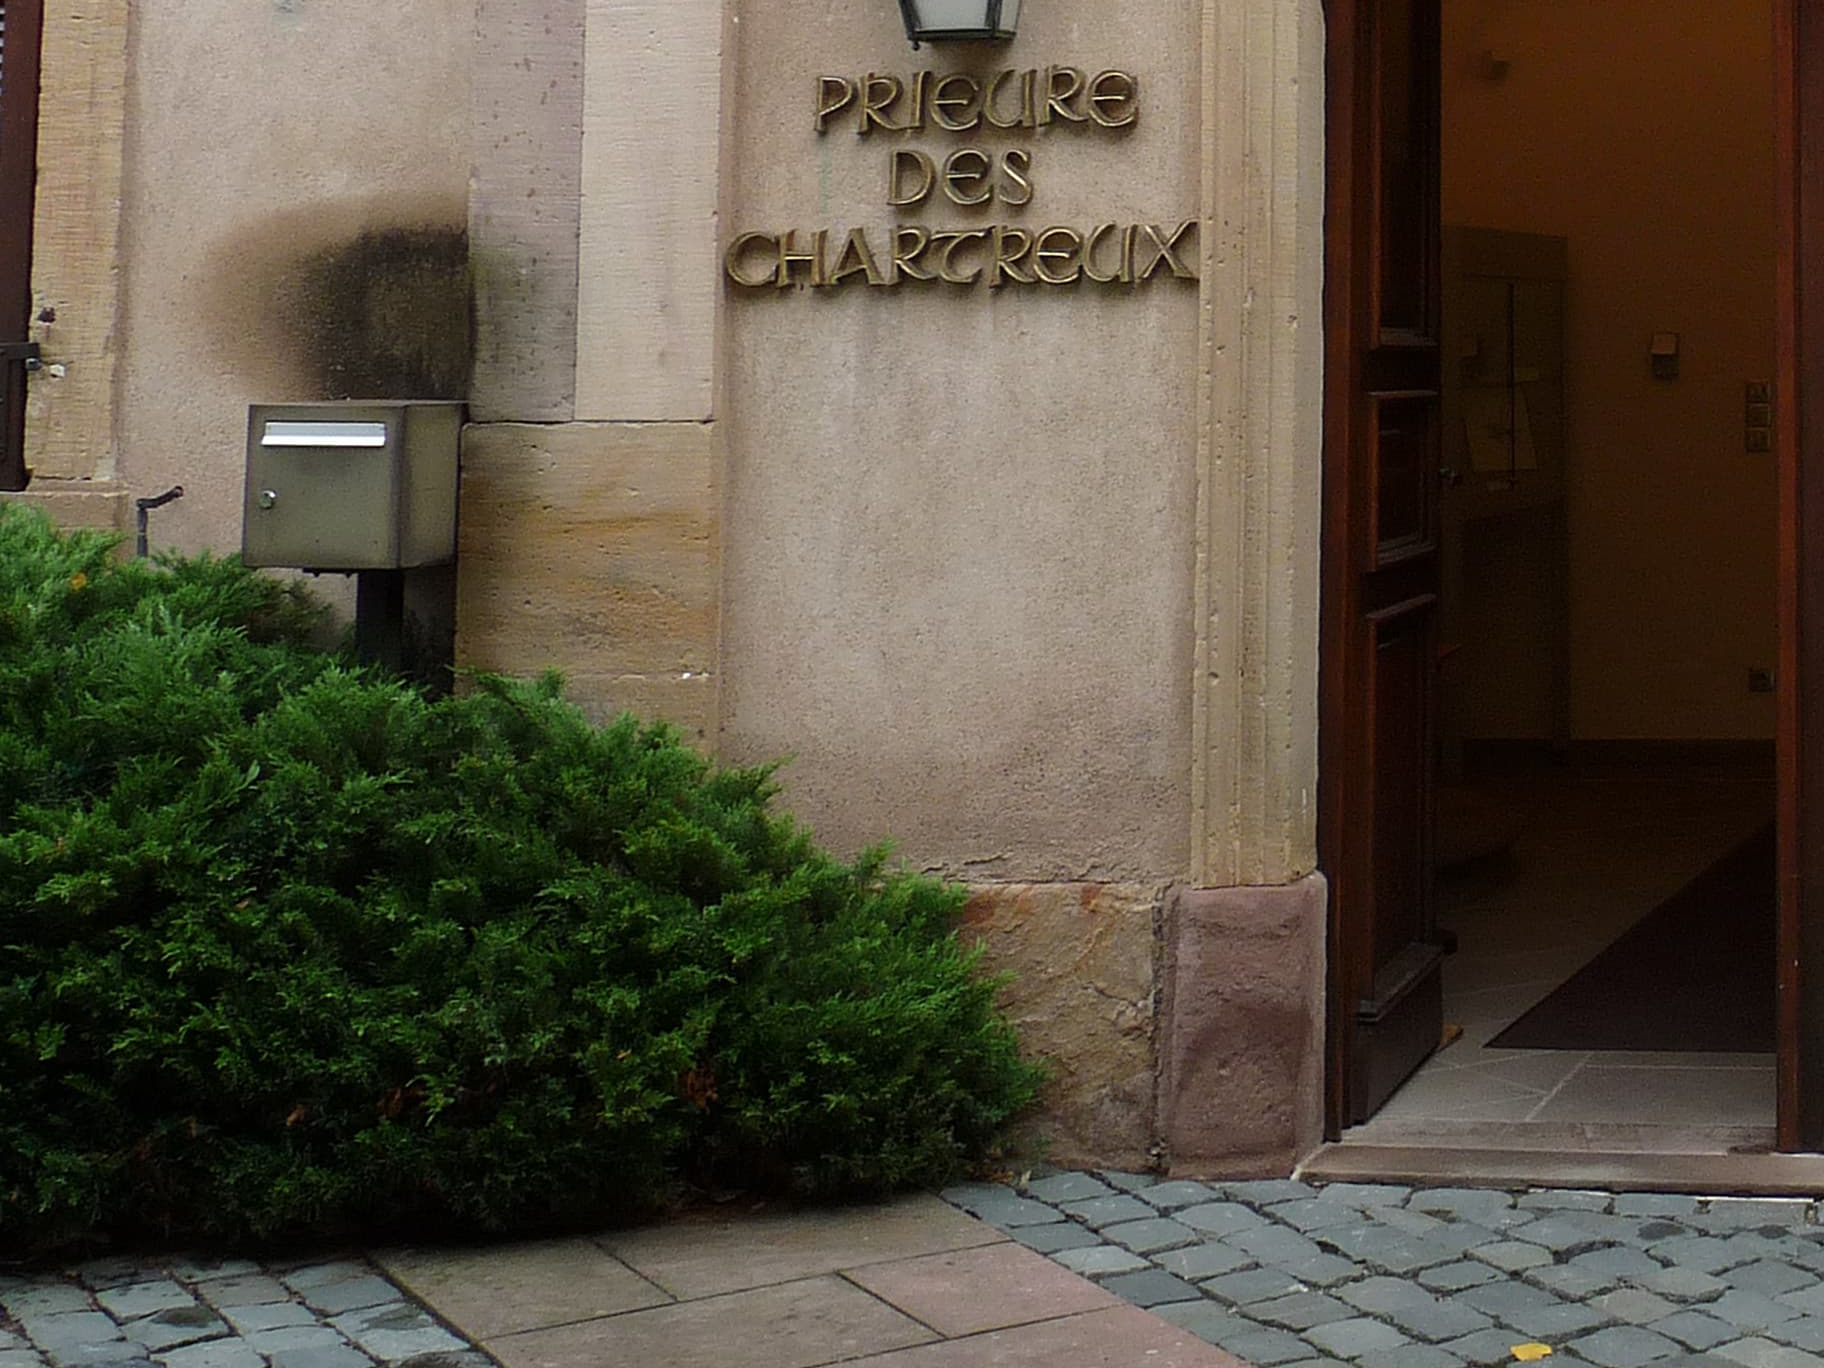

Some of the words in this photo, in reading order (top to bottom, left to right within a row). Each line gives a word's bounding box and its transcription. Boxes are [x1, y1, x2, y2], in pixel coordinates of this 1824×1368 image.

[813, 64, 1140, 134] PRIEURE
[887, 148, 1034, 207] DES
[724, 217, 1200, 290] CHARTREUX
